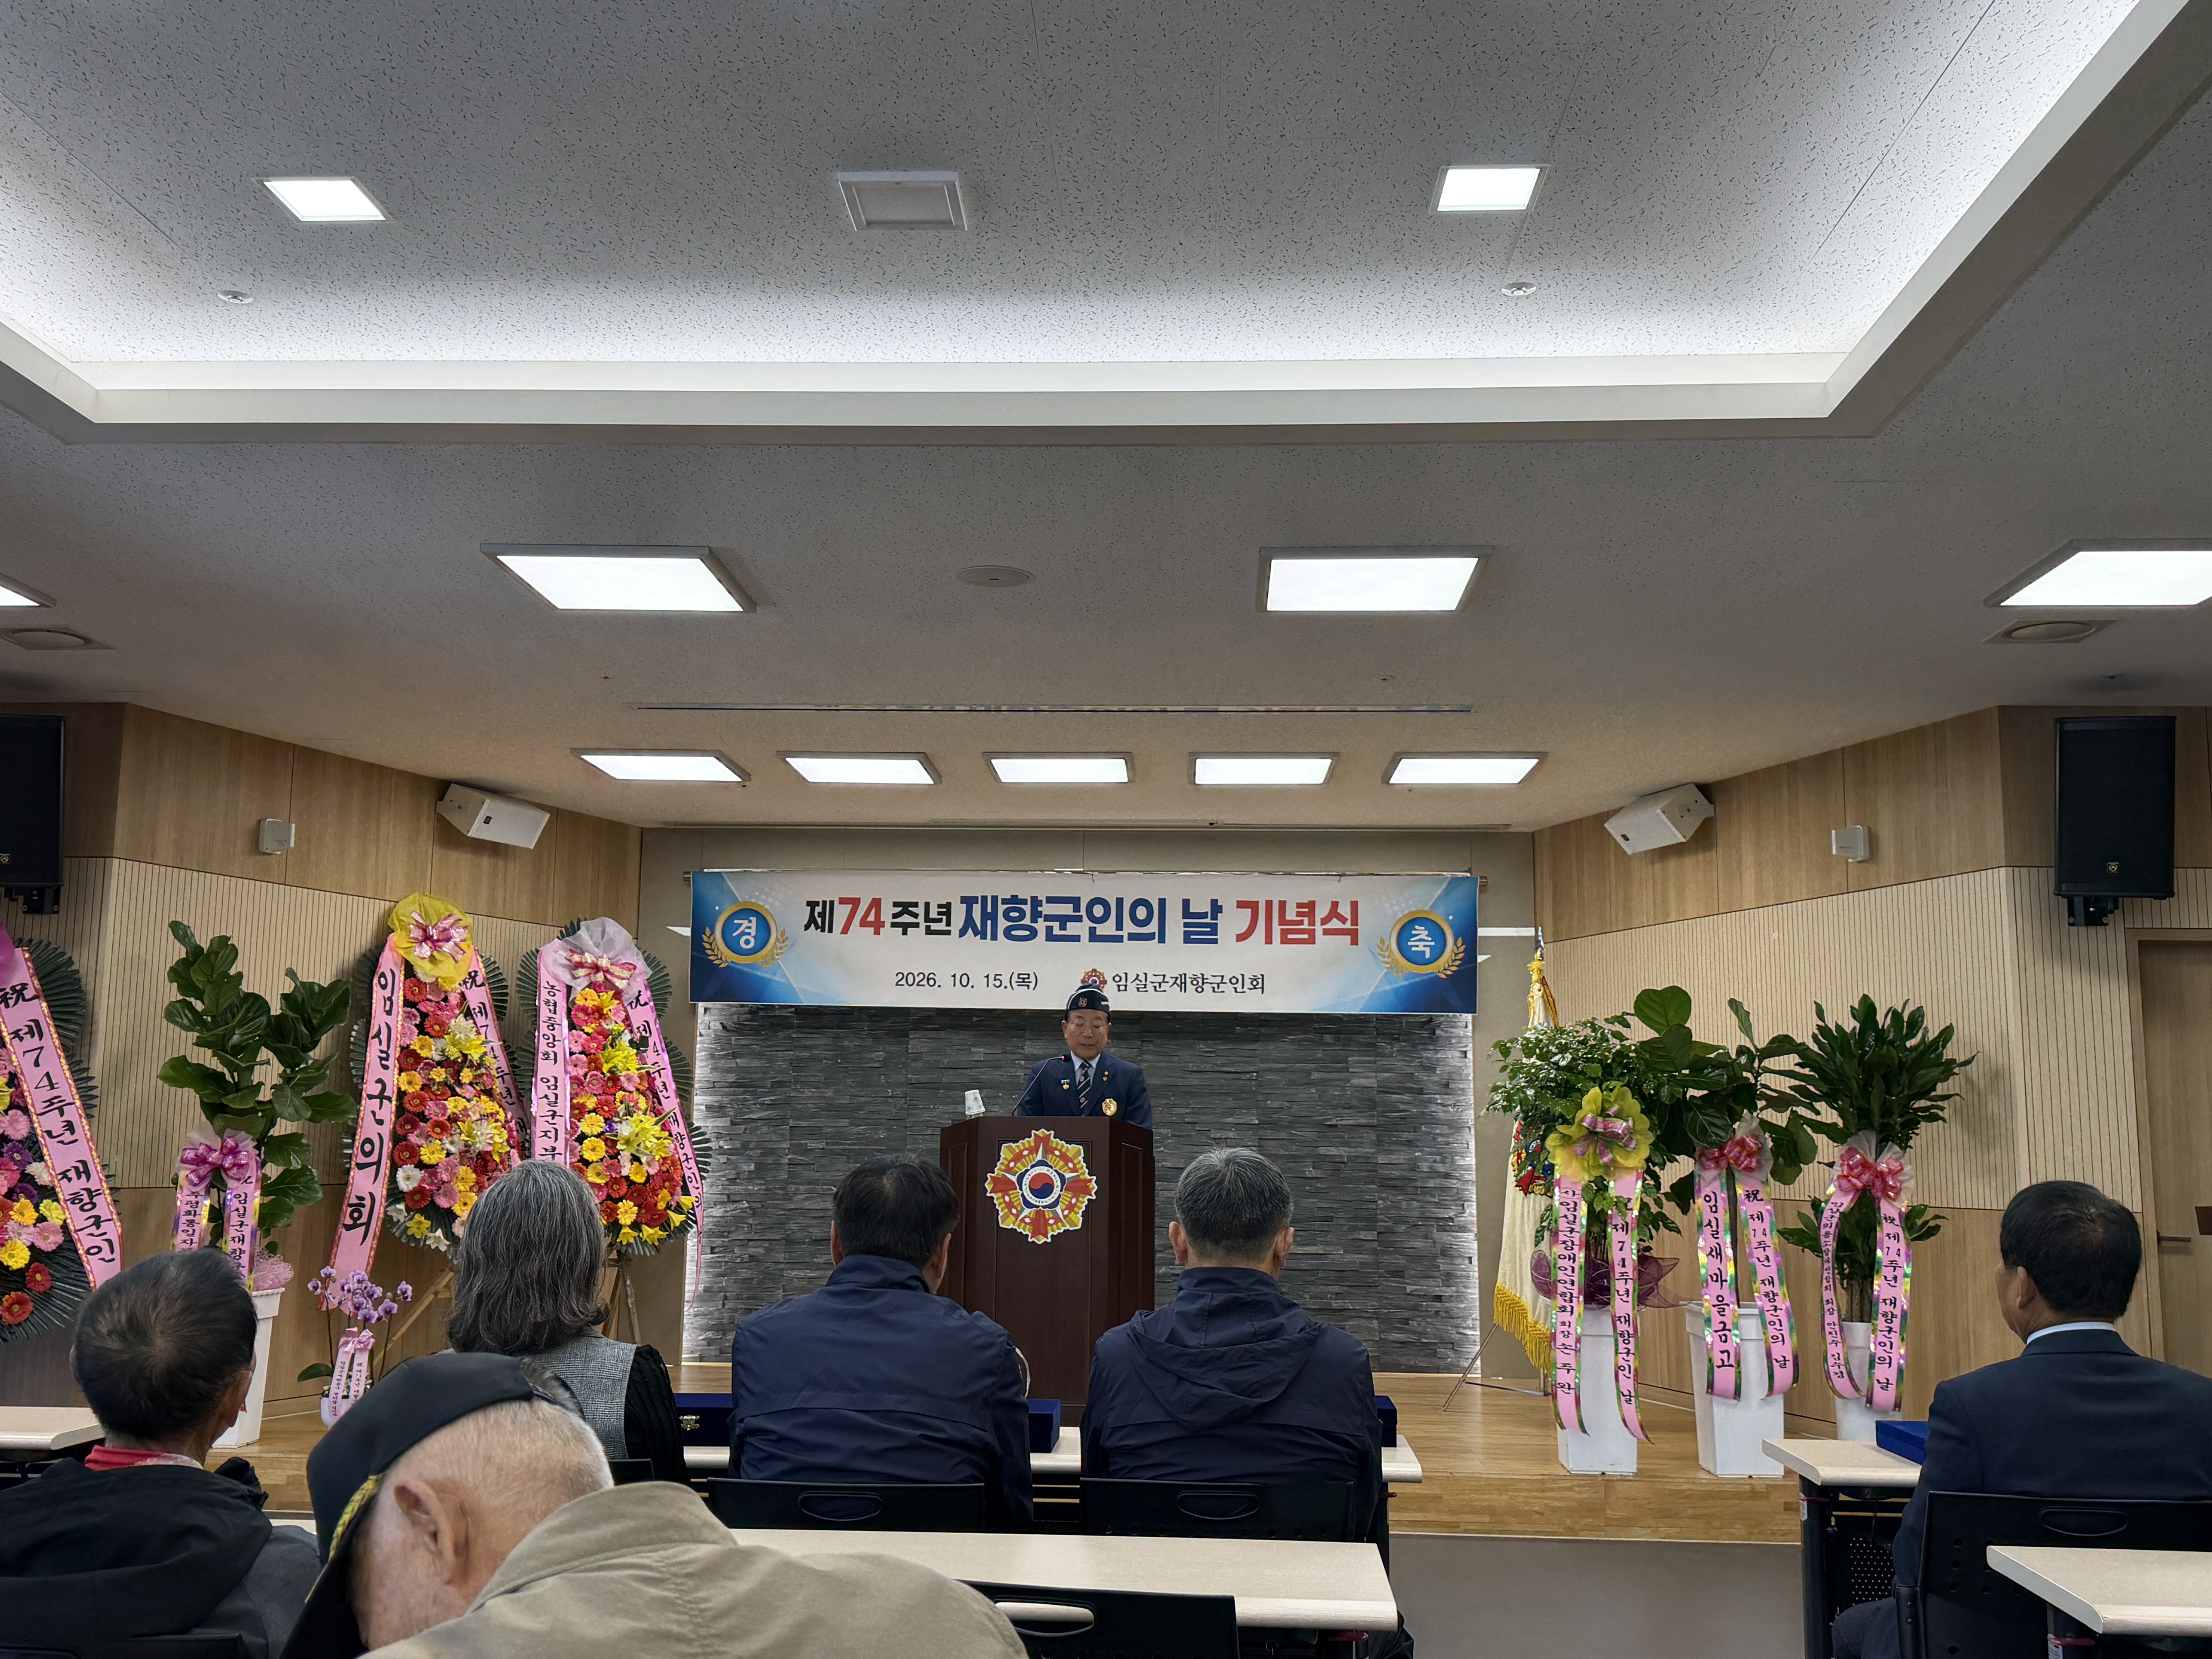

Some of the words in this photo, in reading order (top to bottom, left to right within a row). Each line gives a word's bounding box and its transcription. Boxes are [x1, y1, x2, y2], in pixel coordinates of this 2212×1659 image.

[732, 916, 757, 949] 경
[804, 897, 952, 936] 제74주년
[958, 895, 1166, 944] 재향군인의
[1182, 898, 1223, 945] 날
[1235, 899, 1359, 946] 기념식
[1407, 925, 1435, 958] 축
[895, 972, 941, 988] 2026.
[951, 973, 974, 989] 10.
[984, 972, 1038, 991] 15.(목)
[1112, 972, 1265, 994] 임실군재향군인회
[541, 981, 561, 1065] 농협중앙회
[10, 1019, 78, 1145] 제74주년
[636, 1020, 670, 1099] 제4주년
[342, 968, 396, 1246] 임실군의회
[538, 1076, 563, 1161] 임실군지부
[1744, 1189, 1764, 1203] 祝
[1612, 1221, 1633, 1303] 제74주년
[1748, 1211, 1771, 1267] 제74주년
[1882, 1232, 1902, 1288] 제74주년
[1704, 1191, 1735, 1369] 임실새마을금고
[1760, 1276, 1785, 1347] 재향군인의
[1875, 1296, 1898, 1369] 재향군인의
[1616, 1313, 1635, 1379] 재향군인
[1773, 1355, 1790, 1369] 날
[1620, 1389, 1636, 1405] 날
[1876, 1377, 1893, 1391] 날
